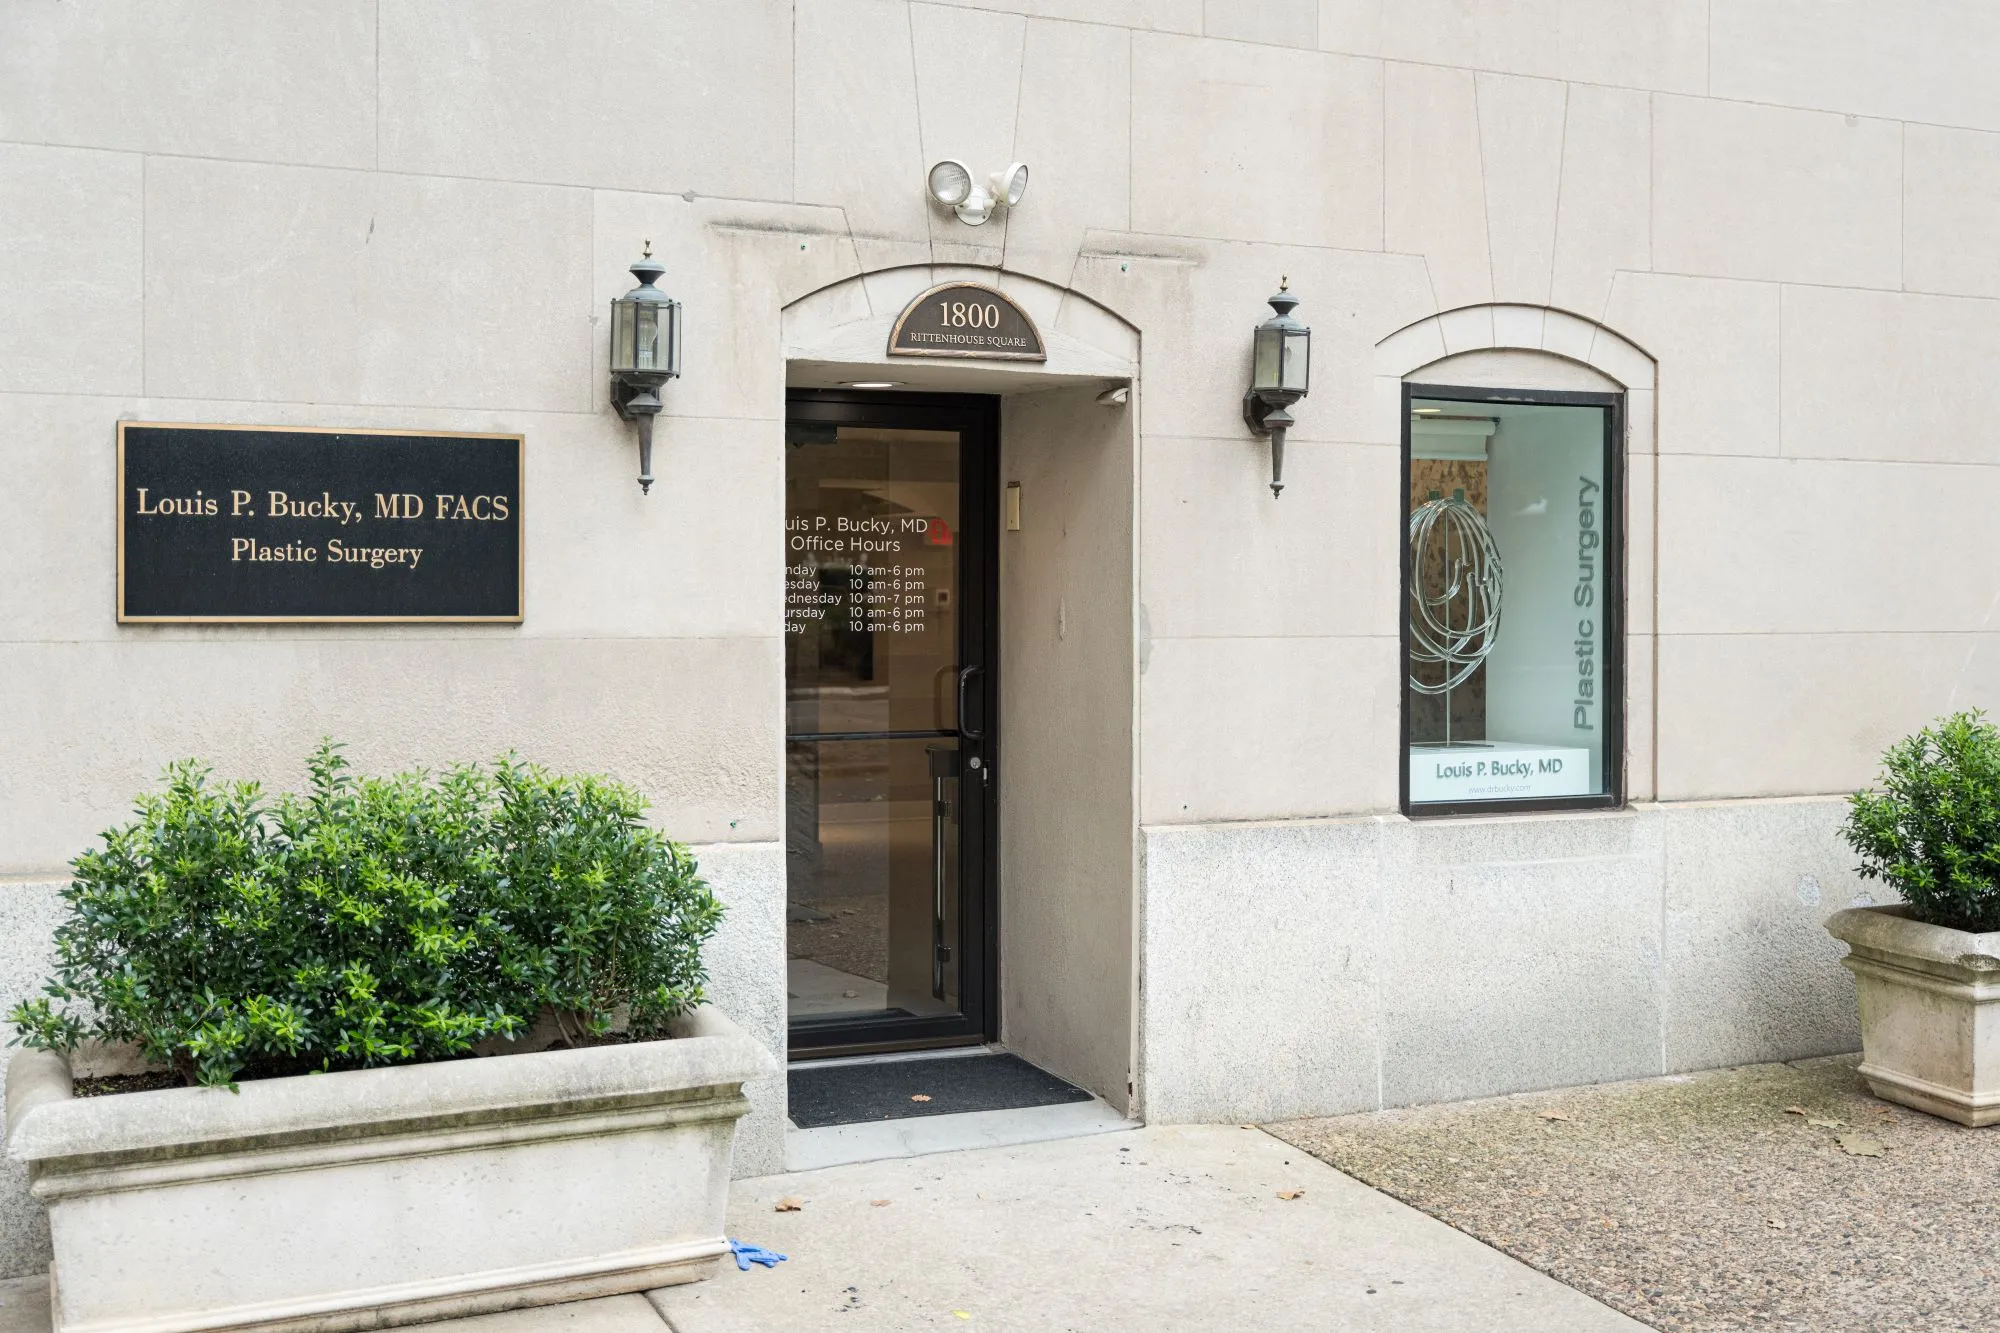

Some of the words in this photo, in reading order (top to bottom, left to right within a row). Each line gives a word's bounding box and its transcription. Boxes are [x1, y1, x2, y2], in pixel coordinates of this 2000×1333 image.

[940, 301, 1000, 329] 1800
[910, 332, 985, 345] RITTENHOUSE
[986, 336, 1027, 347] SQUARE
[136, 488, 218, 516] Louis
[231, 490, 255, 517] P.
[267, 491, 362, 525] Bucky,
[374, 494, 424, 519] MD
[435, 495, 509, 521] FACS
[785, 516, 809, 531] uis
[815, 517, 831, 531] P.
[837, 517, 895, 535] Bucky,
[901, 518, 928, 533] MD
[791, 535, 844, 551] Office
[850, 536, 901, 552] Hours
[1574, 475, 1600, 608] Surgery
[231, 537, 317, 562] Plastic
[327, 539, 424, 569] Surgery
[785, 564, 817, 578] nday
[849, 565, 863, 576] 10
[905, 567, 925, 578] pm
[785, 578, 820, 592] esday
[849, 579, 863, 590] 10
[905, 581, 925, 592] pm
[785, 592, 842, 606] dnesday
[849, 593, 863, 604] 10
[905, 595, 925, 606] pm
[785, 606, 826, 620] ursday
[849, 607, 863, 618] 10
[905, 609, 925, 620] pm
[785, 620, 807, 634] day
[849, 621, 863, 632] 10
[905, 623, 925, 634] pm
[1574, 619, 1594, 731] Plastic
[1436, 761, 1473, 779] Louis
[1476, 761, 1488, 777] P.
[1491, 759, 1534, 779] Bucky,
[1538, 758, 1563, 774] MD
